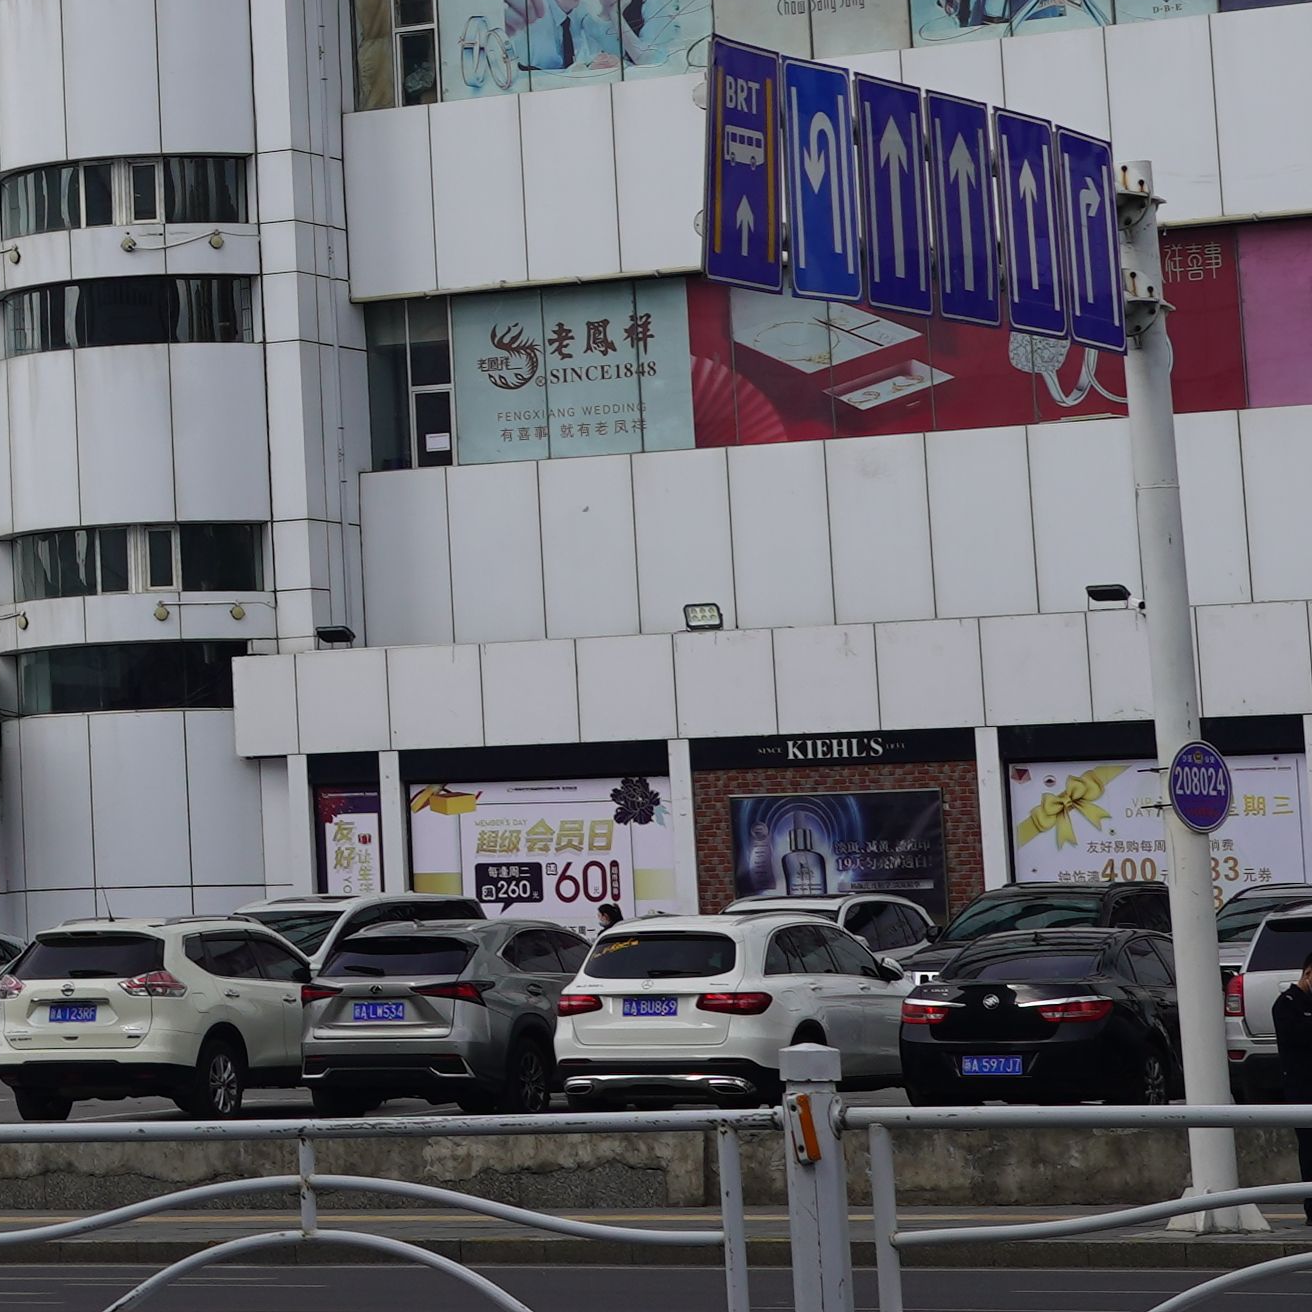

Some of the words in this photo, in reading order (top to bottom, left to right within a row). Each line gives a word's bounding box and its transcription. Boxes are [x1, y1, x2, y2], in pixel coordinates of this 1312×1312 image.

[725, 74, 761, 115] BRT
[1162, 241, 1223, 284] 祥喜事
[497, 407, 575, 422] FENGXIANG
[582, 402, 647, 416] WEDDING
[786, 737, 884, 760] KIEHL'S
[1175, 766, 1226, 797] 208024
[476, 818, 614, 855] 超级会员日
